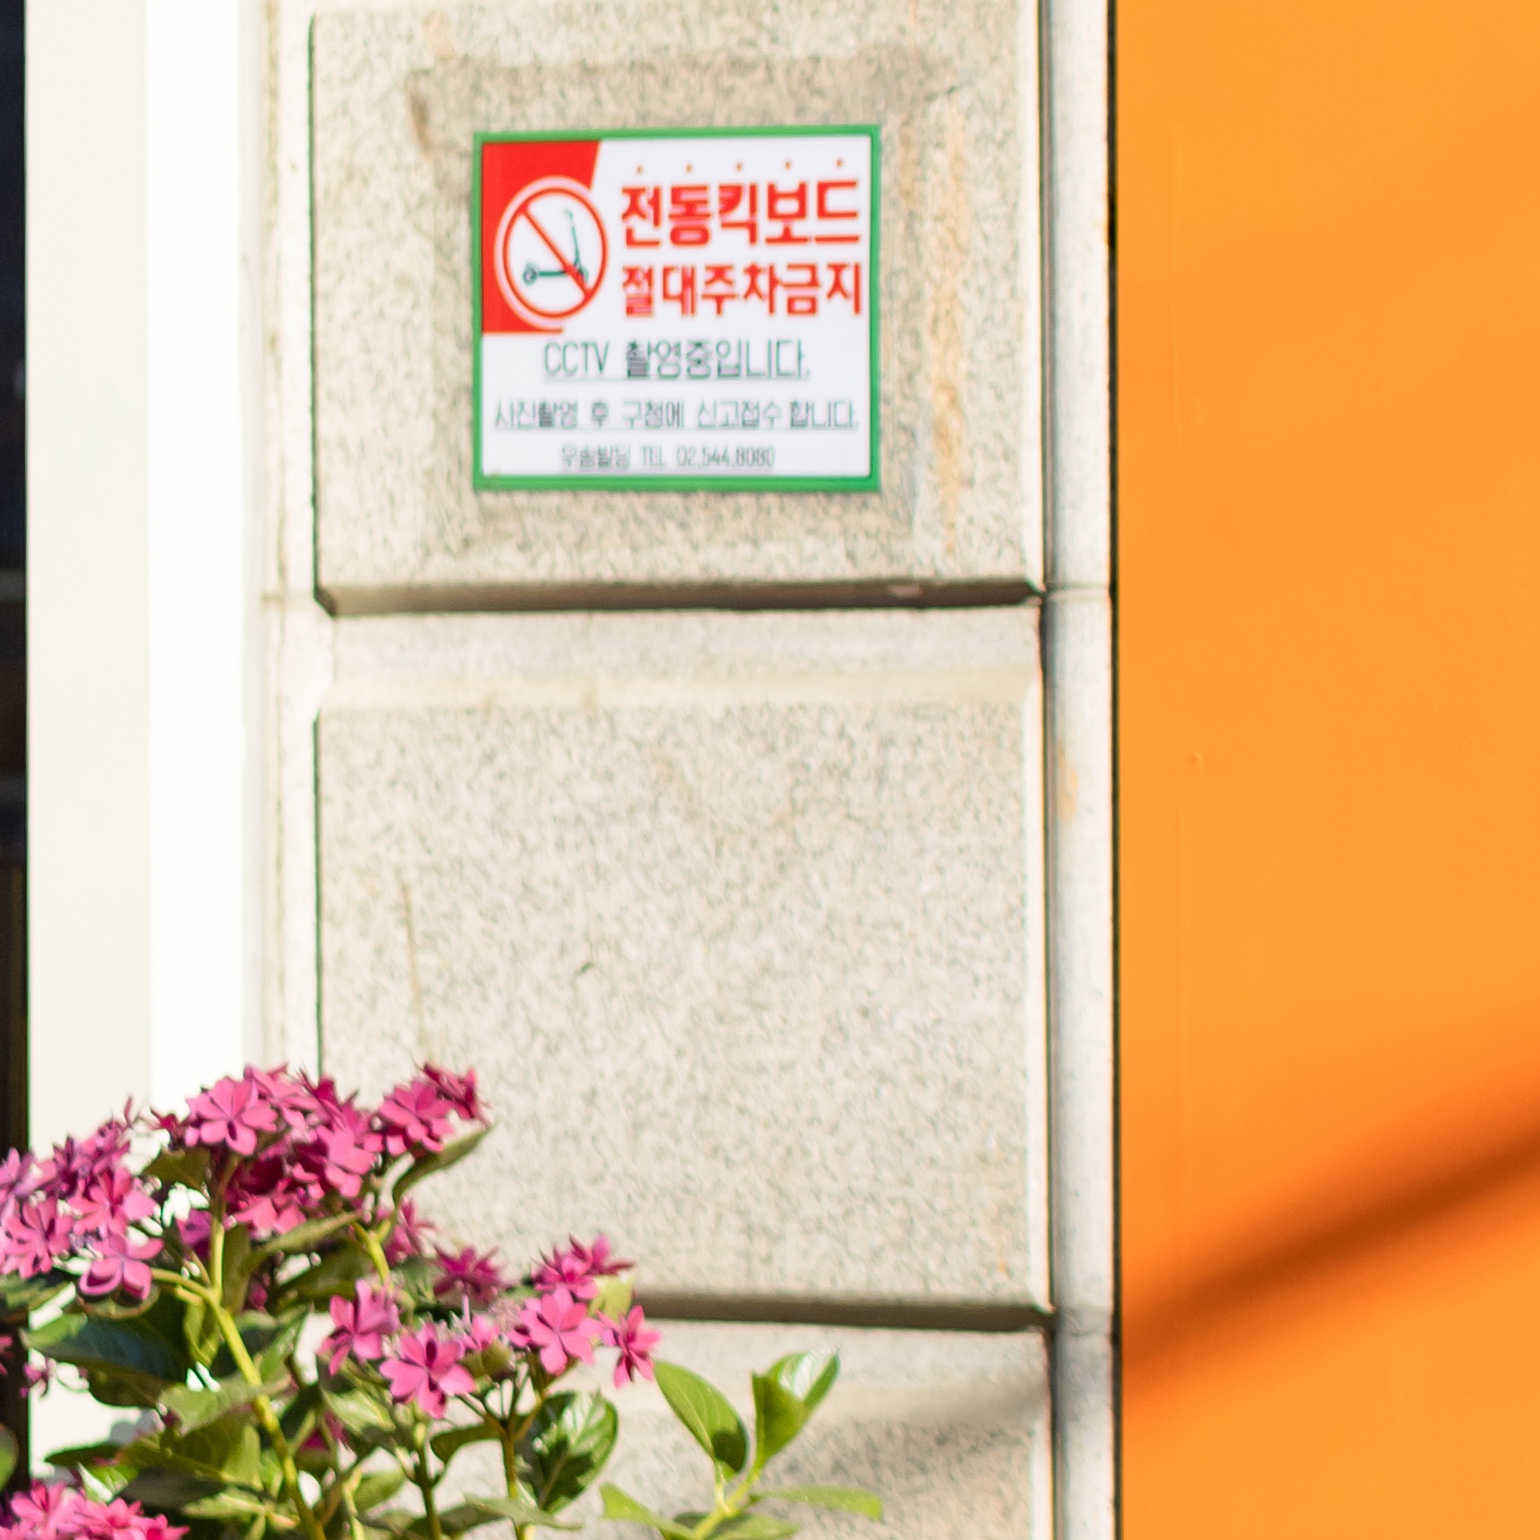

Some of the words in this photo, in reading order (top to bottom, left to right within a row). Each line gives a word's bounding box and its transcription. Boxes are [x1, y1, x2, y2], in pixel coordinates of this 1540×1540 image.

[621, 180, 862, 248] 전동킥보드
[621, 261, 863, 317] 절대주차금지
[543, 340, 611, 377] CCTV
[626, 338, 811, 380] 촬영중입니다.
[495, 399, 578, 429] 사진촬영
[591, 399, 609, 428] 후
[622, 399, 685, 429] 구청에
[697, 399, 782, 429] 신고접수
[642, 445, 667, 467] TEL
